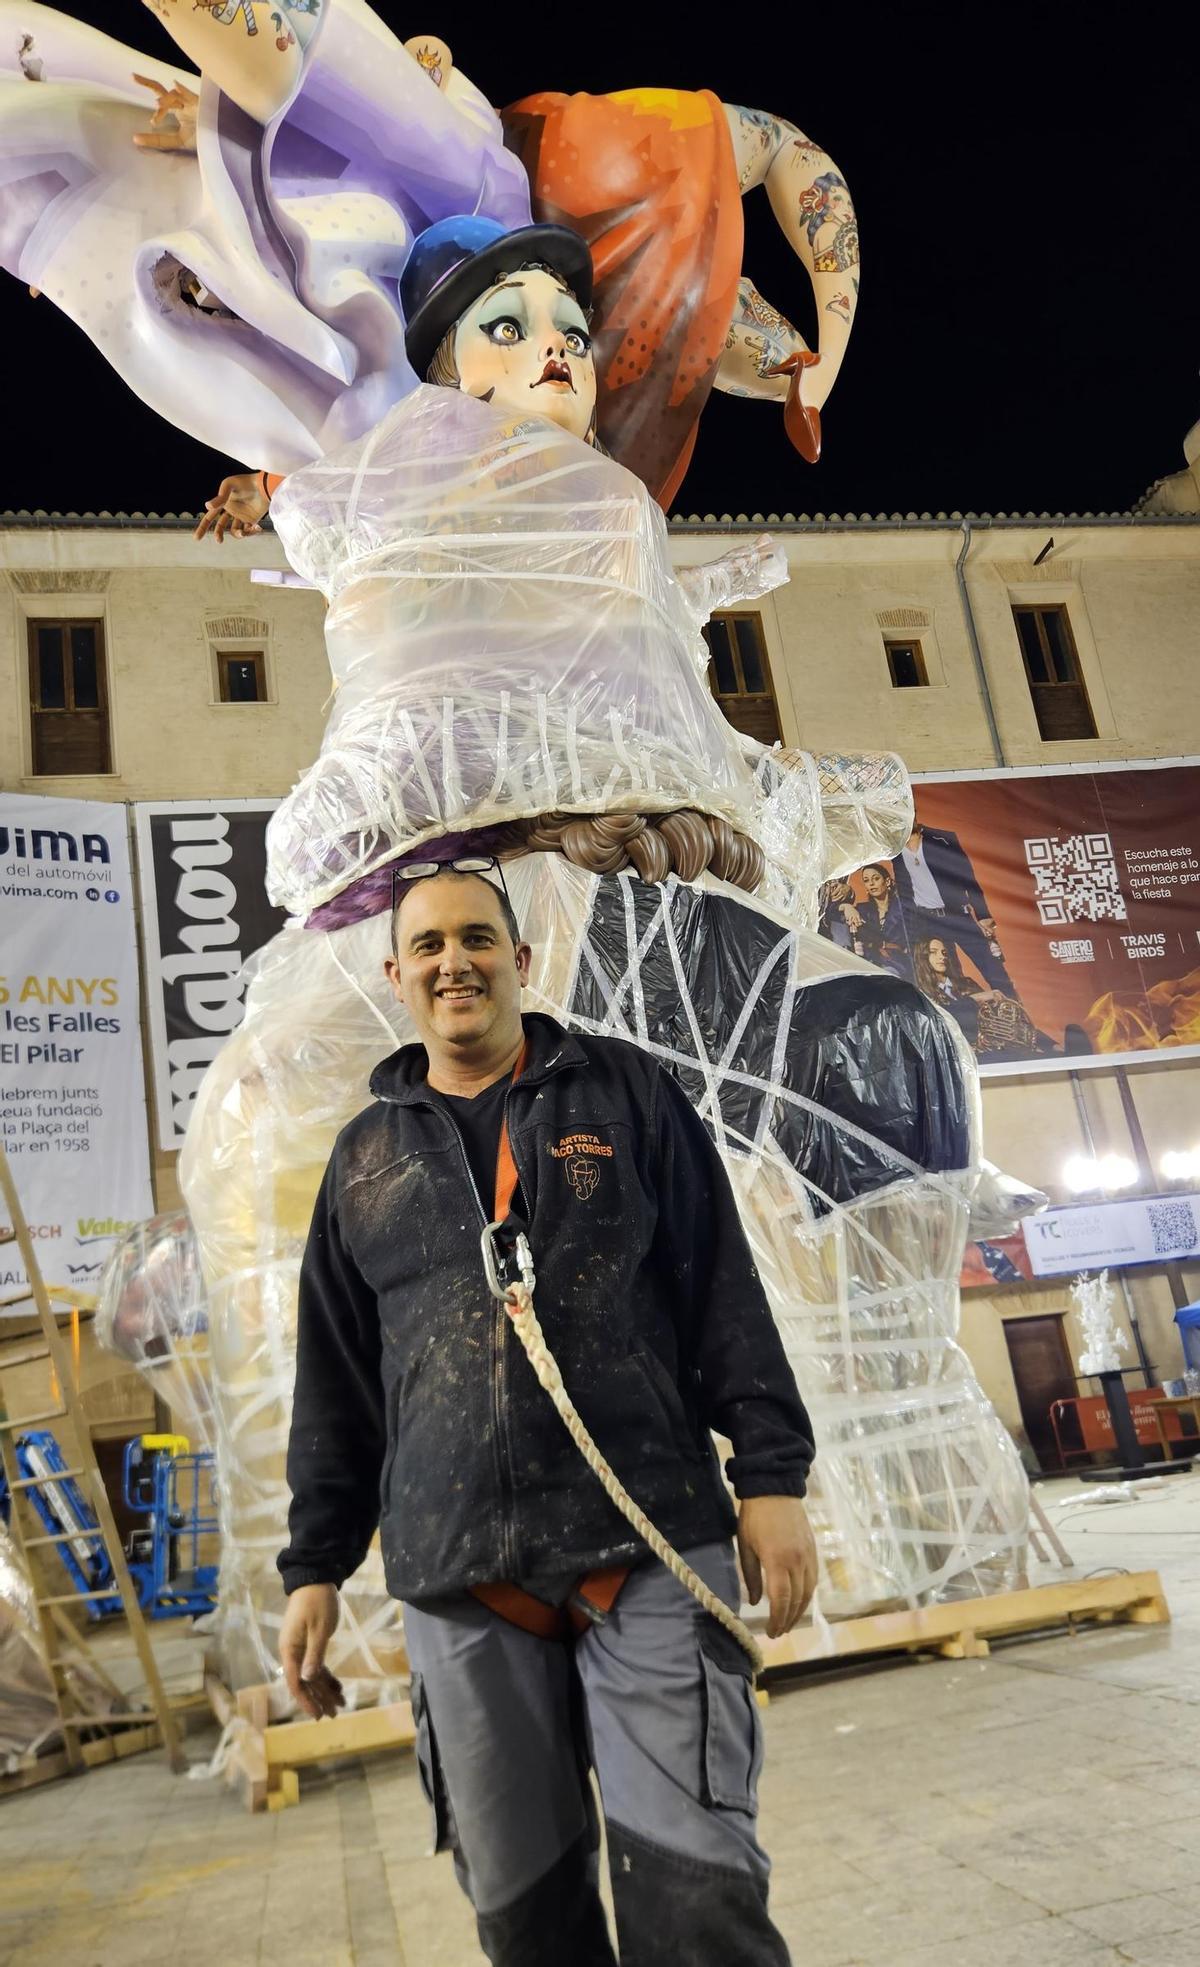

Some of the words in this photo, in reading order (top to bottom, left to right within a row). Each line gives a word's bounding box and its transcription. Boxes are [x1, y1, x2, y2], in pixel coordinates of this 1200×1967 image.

[1124, 848, 1169, 860] Escucha
[1170, 846, 1192, 856] este
[6, 864, 30, 877] del
[35, 867, 112, 883] automóvil
[1127, 860, 1178, 873] homenaje
[1180, 861, 1188, 869] a
[1188, 859, 1199, 868] lo
[1129, 876, 1151, 888] que
[1152, 875, 1178, 885] hace
[0, 884, 78, 900] vima.com
[1132, 890, 1143, 899] la
[1143, 888, 1172, 899] fiesta
[1120, 933, 1166, 947] TRAVIS
[1127, 946, 1165, 959] BIRDS
[19, 975, 119, 1006] ANYS
[6, 1010, 41, 1033] les
[48, 1012, 121, 1034] Falles
[27, 1043, 84, 1064] Pilar
[61, 1086, 99, 1103] junts
[37, 1103, 103, 1118] fundació
[3, 1121, 17, 1135] la
[21, 1121, 62, 1137] Plaça
[67, 1120, 89, 1133] del
[3, 1139, 25, 1154] lar
[29, 1141, 50, 1153] en
[54, 1138, 91, 1152] 1958
[559, 1134, 600, 1147] ARTISTA
[575, 1143, 613, 1157] TORRES
